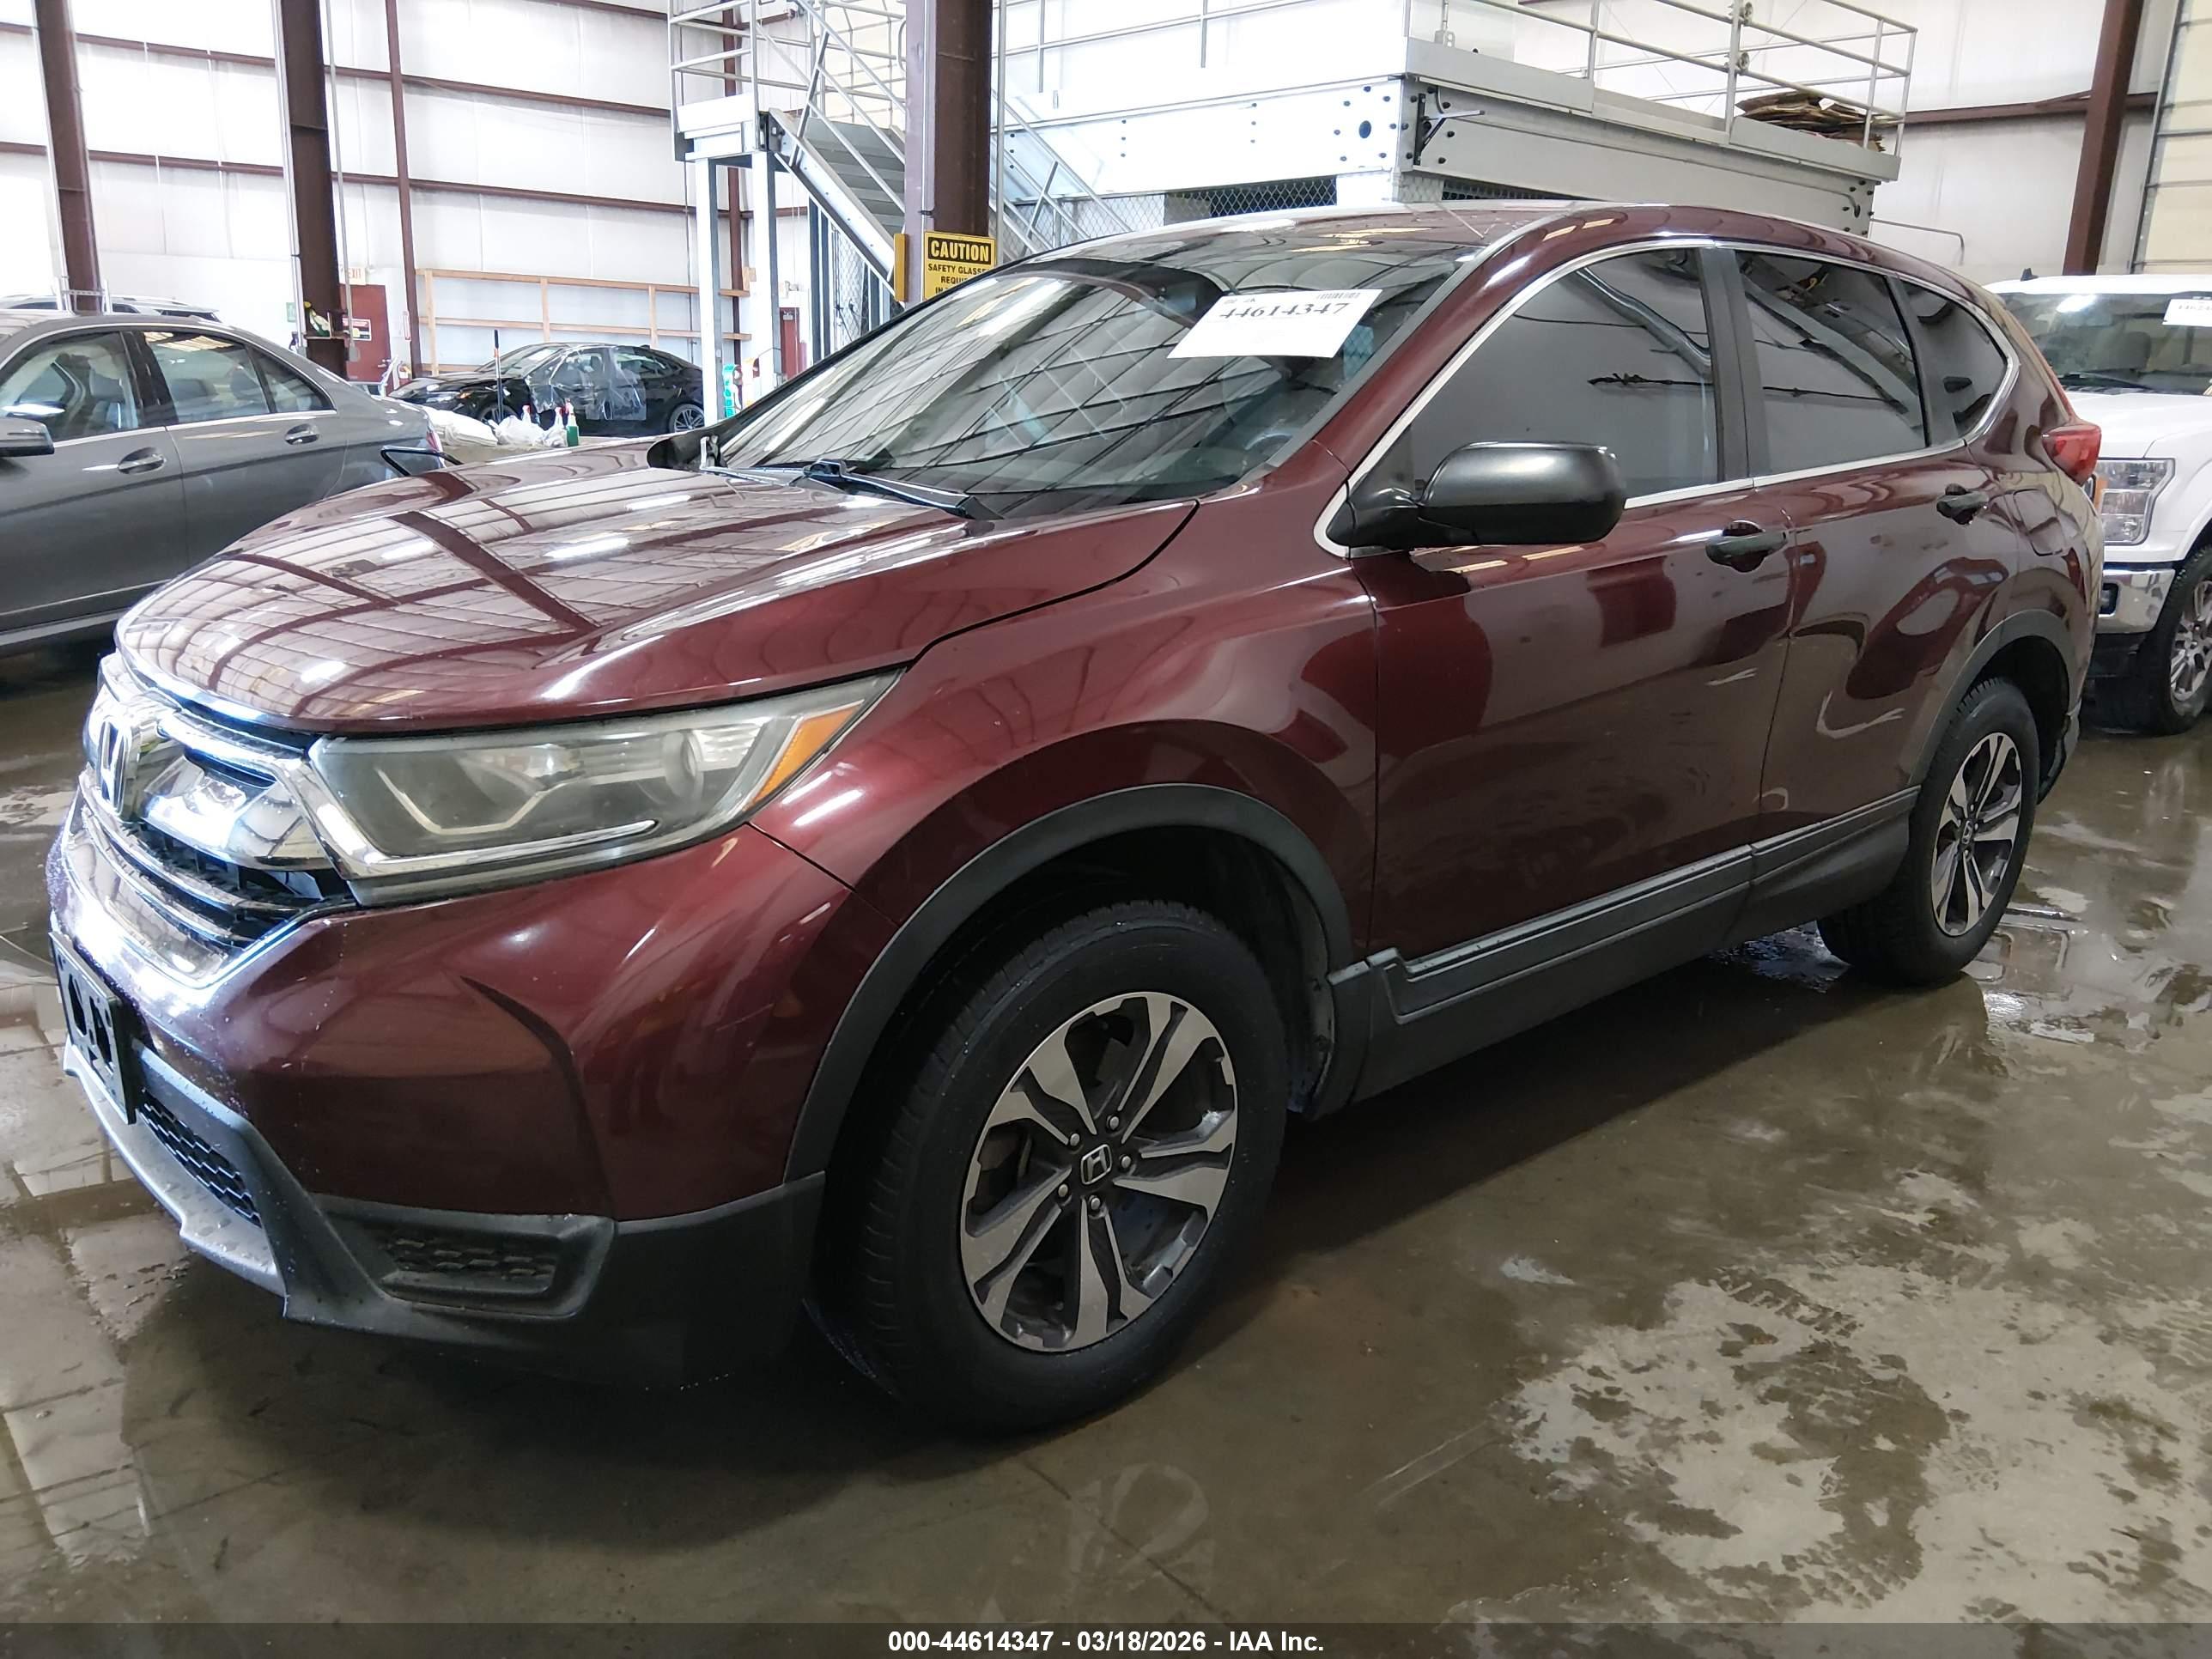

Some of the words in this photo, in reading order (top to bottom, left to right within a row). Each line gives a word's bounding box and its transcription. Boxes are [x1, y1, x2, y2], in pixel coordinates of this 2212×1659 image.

[931, 240, 989, 262] CAUTION
[928, 263, 956, 273] SAFETY
[957, 265, 989, 275] GLASS
[1219, 302, 1350, 319] 44614347
